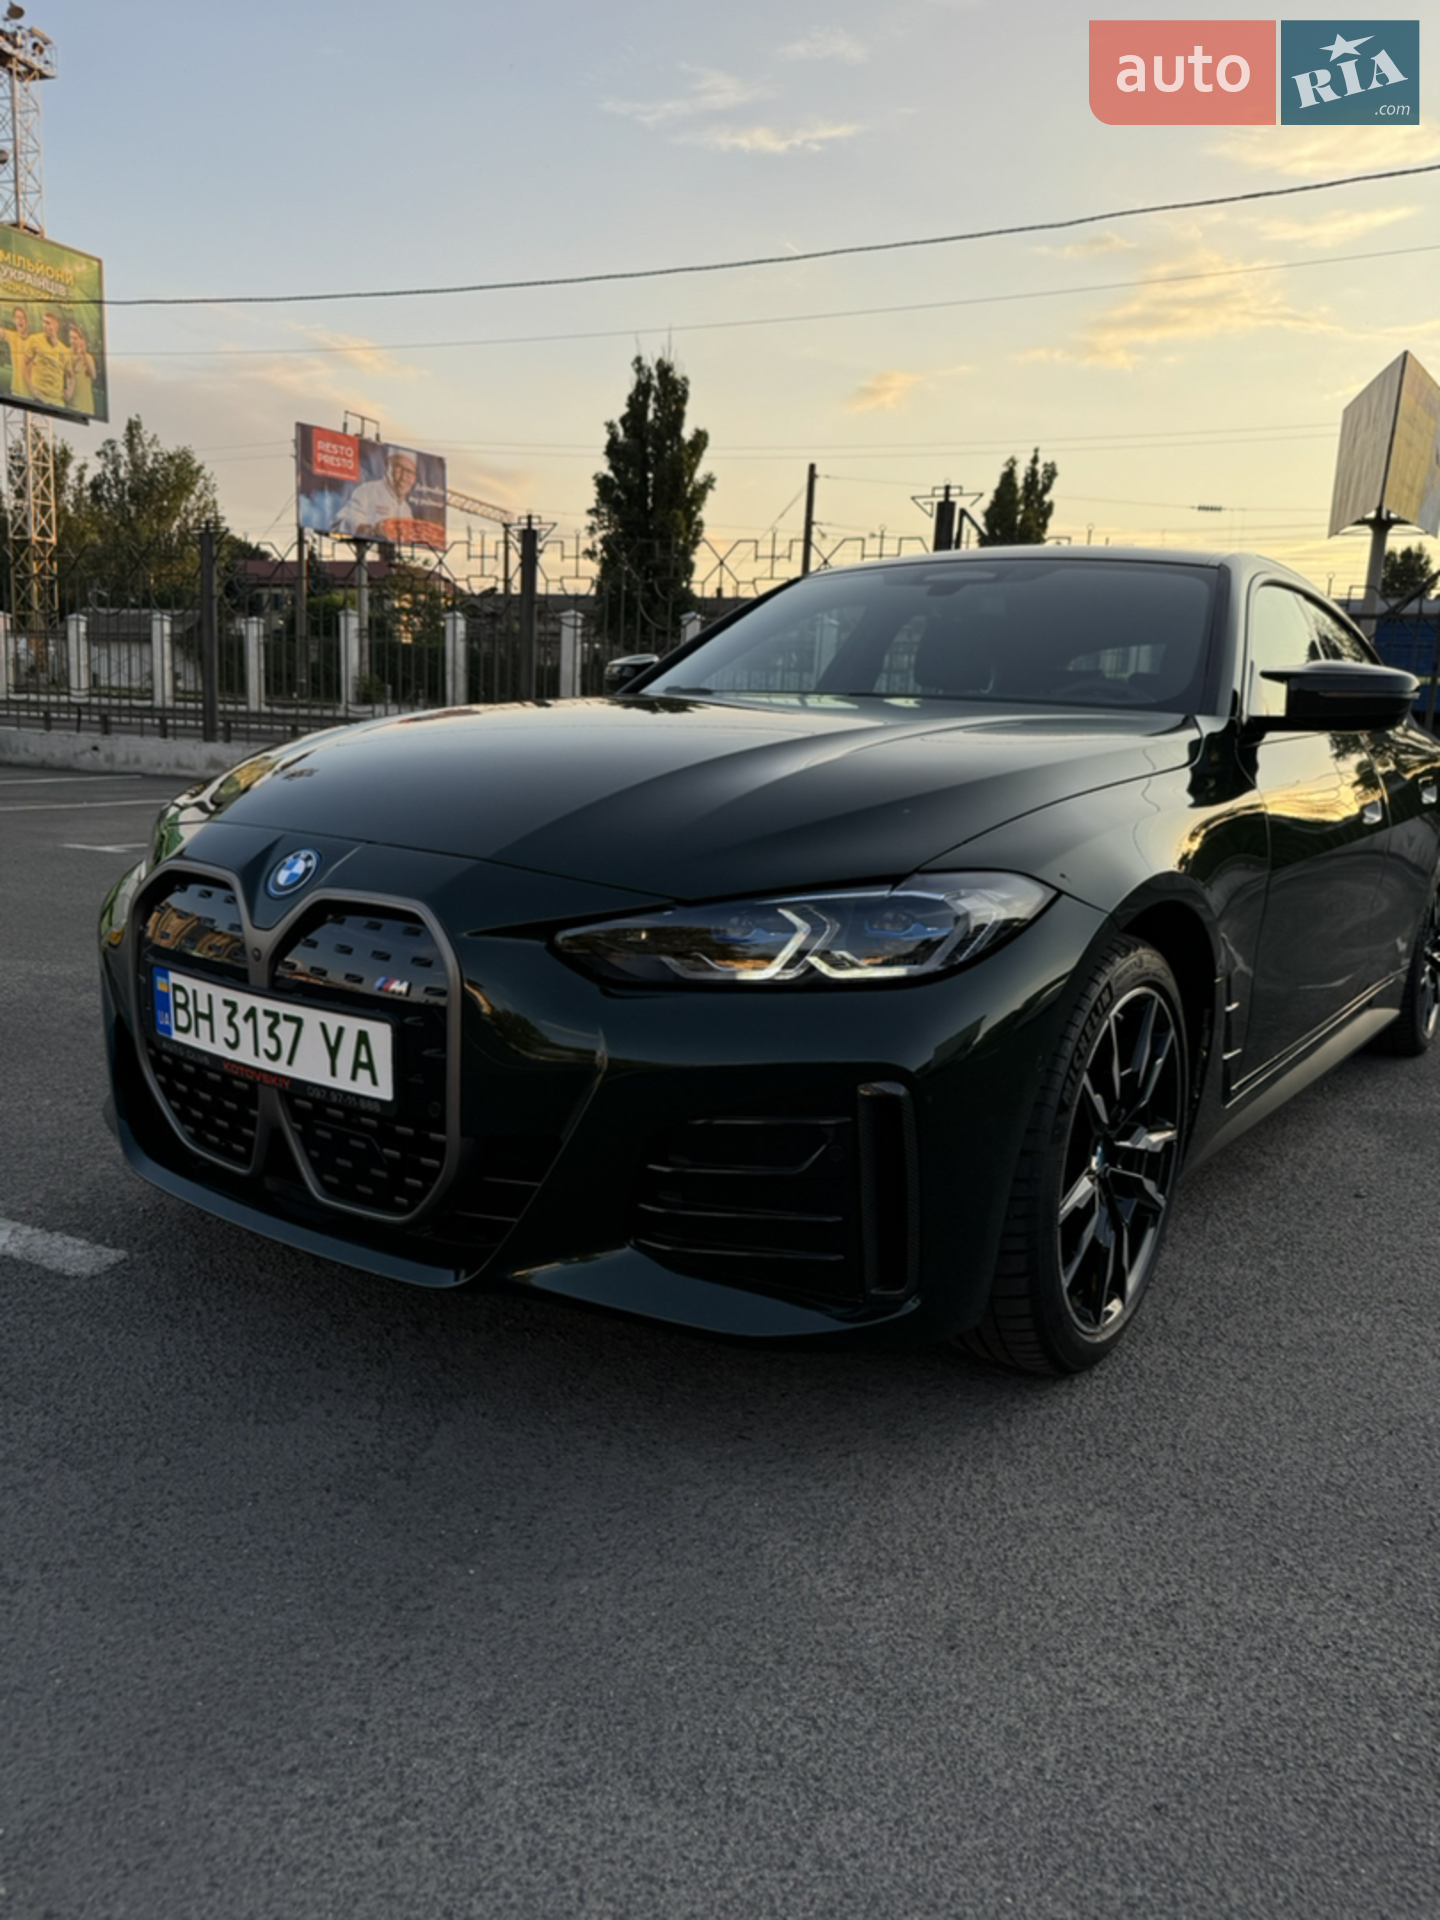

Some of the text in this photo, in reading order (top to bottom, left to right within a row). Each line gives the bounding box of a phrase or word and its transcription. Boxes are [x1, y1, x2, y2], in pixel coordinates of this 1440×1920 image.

[0, 248, 75, 286] МІЛЬЙОНИ
[317, 453, 354, 470] PRESTO
[318, 440, 355, 457] RESTO
[171, 982, 379, 1087] BH 3137 YA
[1063, 980, 1114, 1106] MICHELIN
